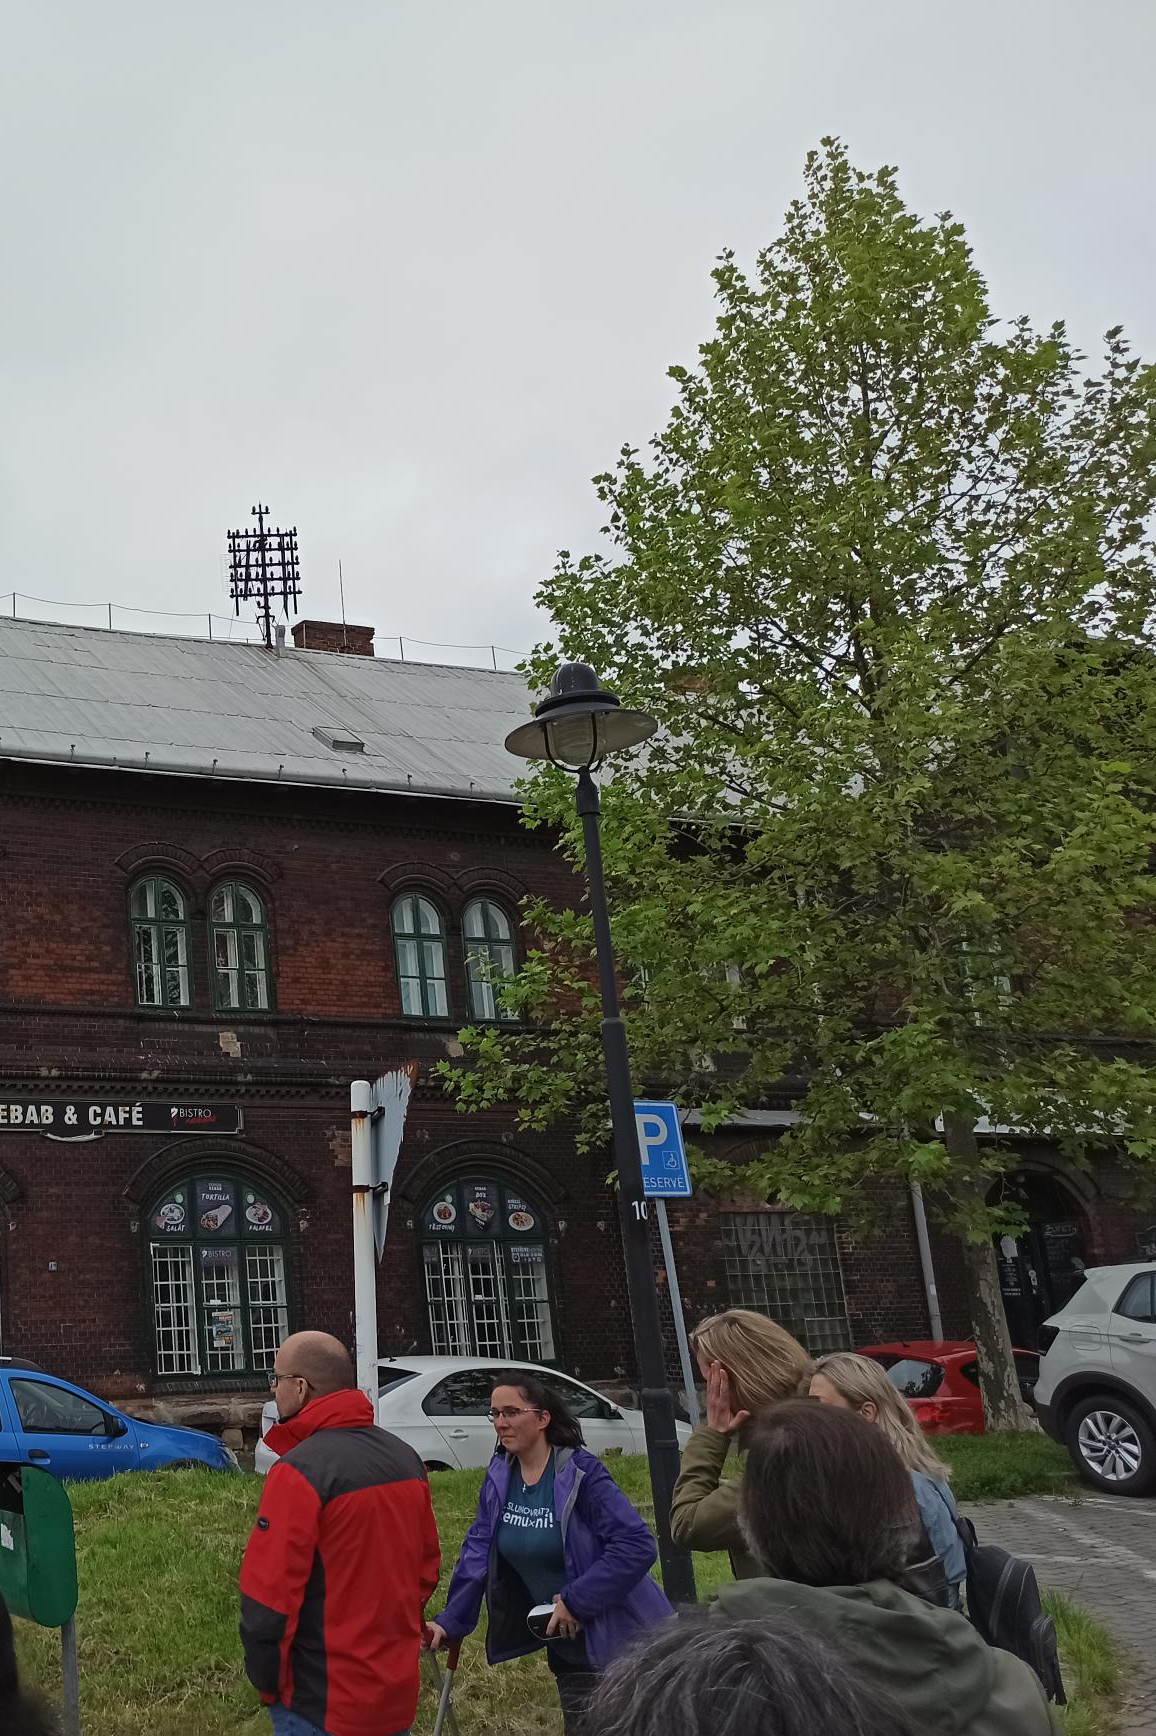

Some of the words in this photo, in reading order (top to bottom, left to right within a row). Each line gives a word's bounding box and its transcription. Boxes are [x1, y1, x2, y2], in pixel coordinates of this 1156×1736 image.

[63, 1104, 78, 1126] &
[88, 1101, 144, 1126] CAFÉ
[178, 1107, 213, 1119] BISTRO
[635, 1113, 669, 1166] P
[643, 1174, 685, 1188] ÉSERVÉ
[201, 1193, 231, 1201] TORTILLA
[208, 1249, 233, 1258] BISTRO
